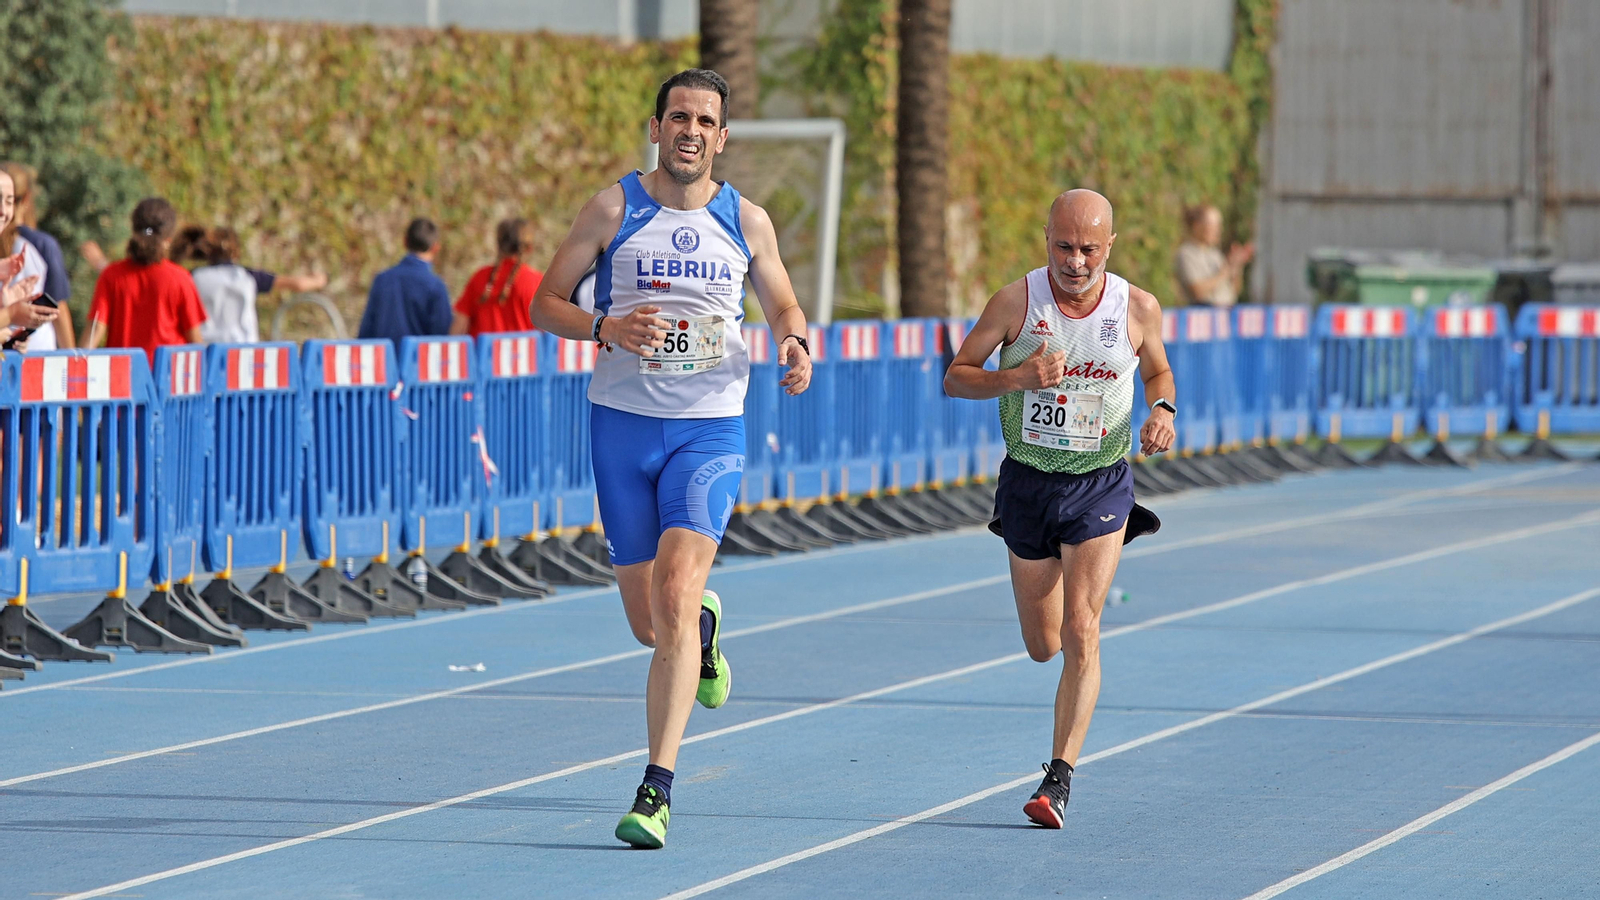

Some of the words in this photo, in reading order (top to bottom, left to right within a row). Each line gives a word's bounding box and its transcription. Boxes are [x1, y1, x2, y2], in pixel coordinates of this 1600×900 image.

[636, 250, 650, 258] Club
[651, 250, 681, 259] Atletismo
[636, 259, 732, 281] LEBRIJA
[637, 280, 671, 289] BigMat
[654, 332, 689, 354] 56
[1030, 402, 1066, 428] 230
[695, 462, 726, 485] CLUB
